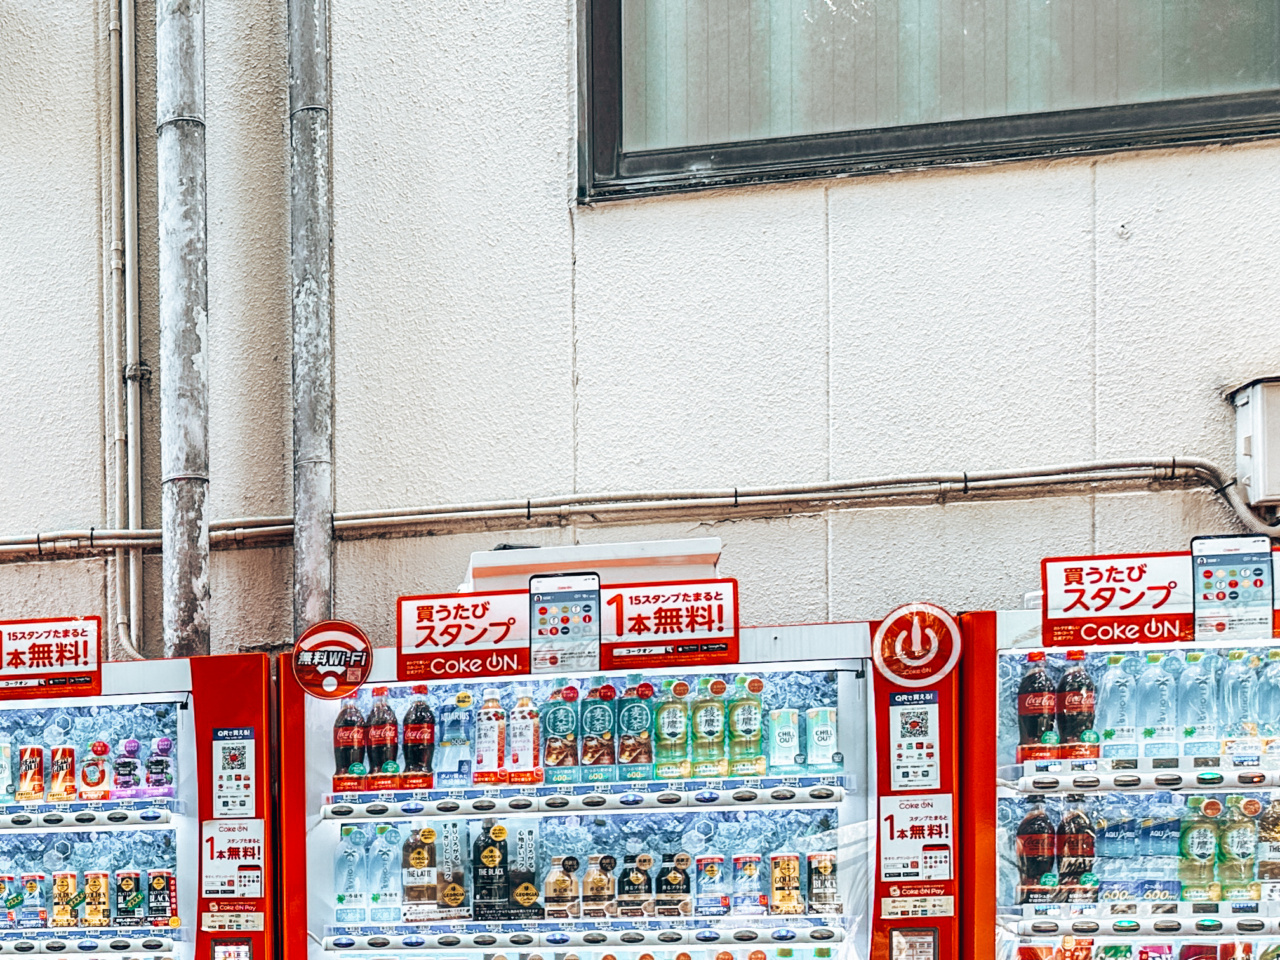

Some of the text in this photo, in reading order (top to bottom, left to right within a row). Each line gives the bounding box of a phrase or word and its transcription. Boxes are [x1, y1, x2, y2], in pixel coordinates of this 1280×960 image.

[1063, 563, 1147, 586] 買うたび
[1062, 581, 1177, 613] スタンプ
[416, 601, 490, 623] 買うたび
[415, 618, 516, 648] スタンプ
[1081, 623, 1139, 641] Coke
[297, 648, 367, 668] 無料Wi-Fi
[431, 657, 482, 674] Coke
[777, 731, 795, 740] CHILL
[815, 729, 834, 738] CHILL
[816, 736, 832, 744] OUT
[779, 737, 794, 745] OUT
[899, 801, 919, 810] Coke
[488, 868, 504, 876] BLACK
[931, 888, 945, 896] Pay
